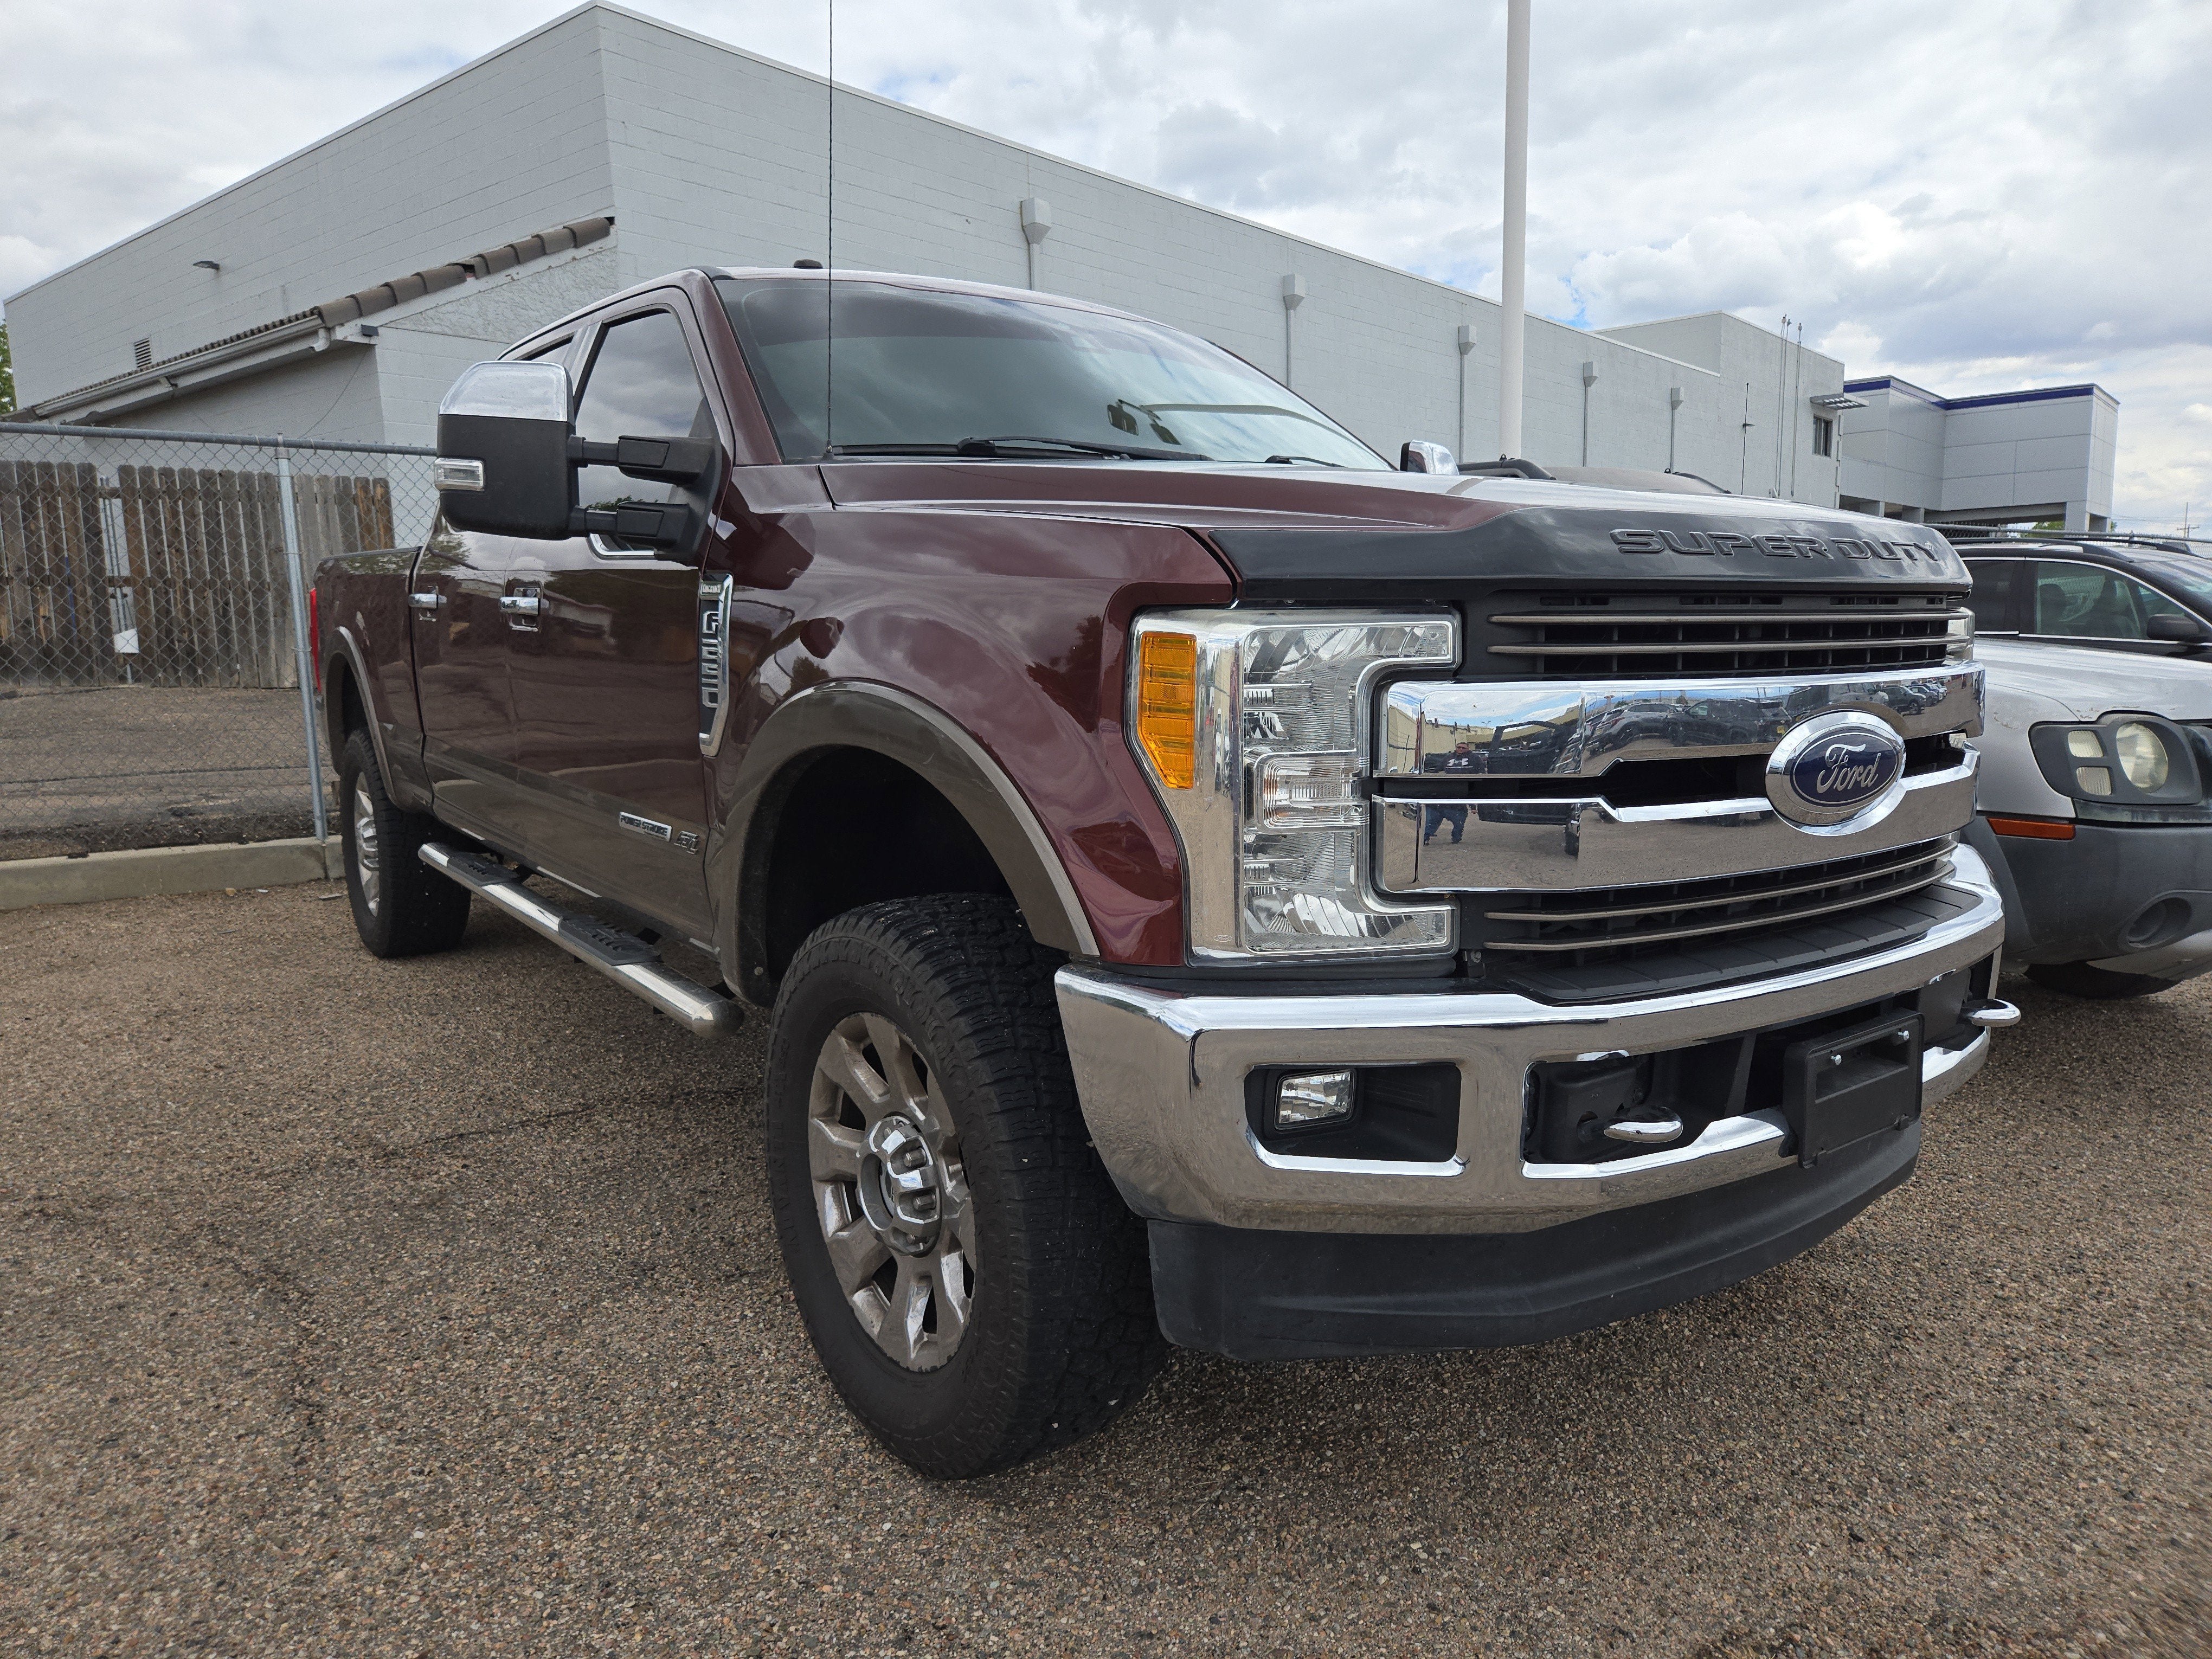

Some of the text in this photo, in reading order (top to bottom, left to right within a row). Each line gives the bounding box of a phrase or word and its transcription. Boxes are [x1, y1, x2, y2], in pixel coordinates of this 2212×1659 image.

[1609, 529, 1939, 562] SUPER DUTY
[1816, 743, 1881, 794] Ford
[621, 814, 641, 828] POWER
[641, 821, 668, 837] STROKE
